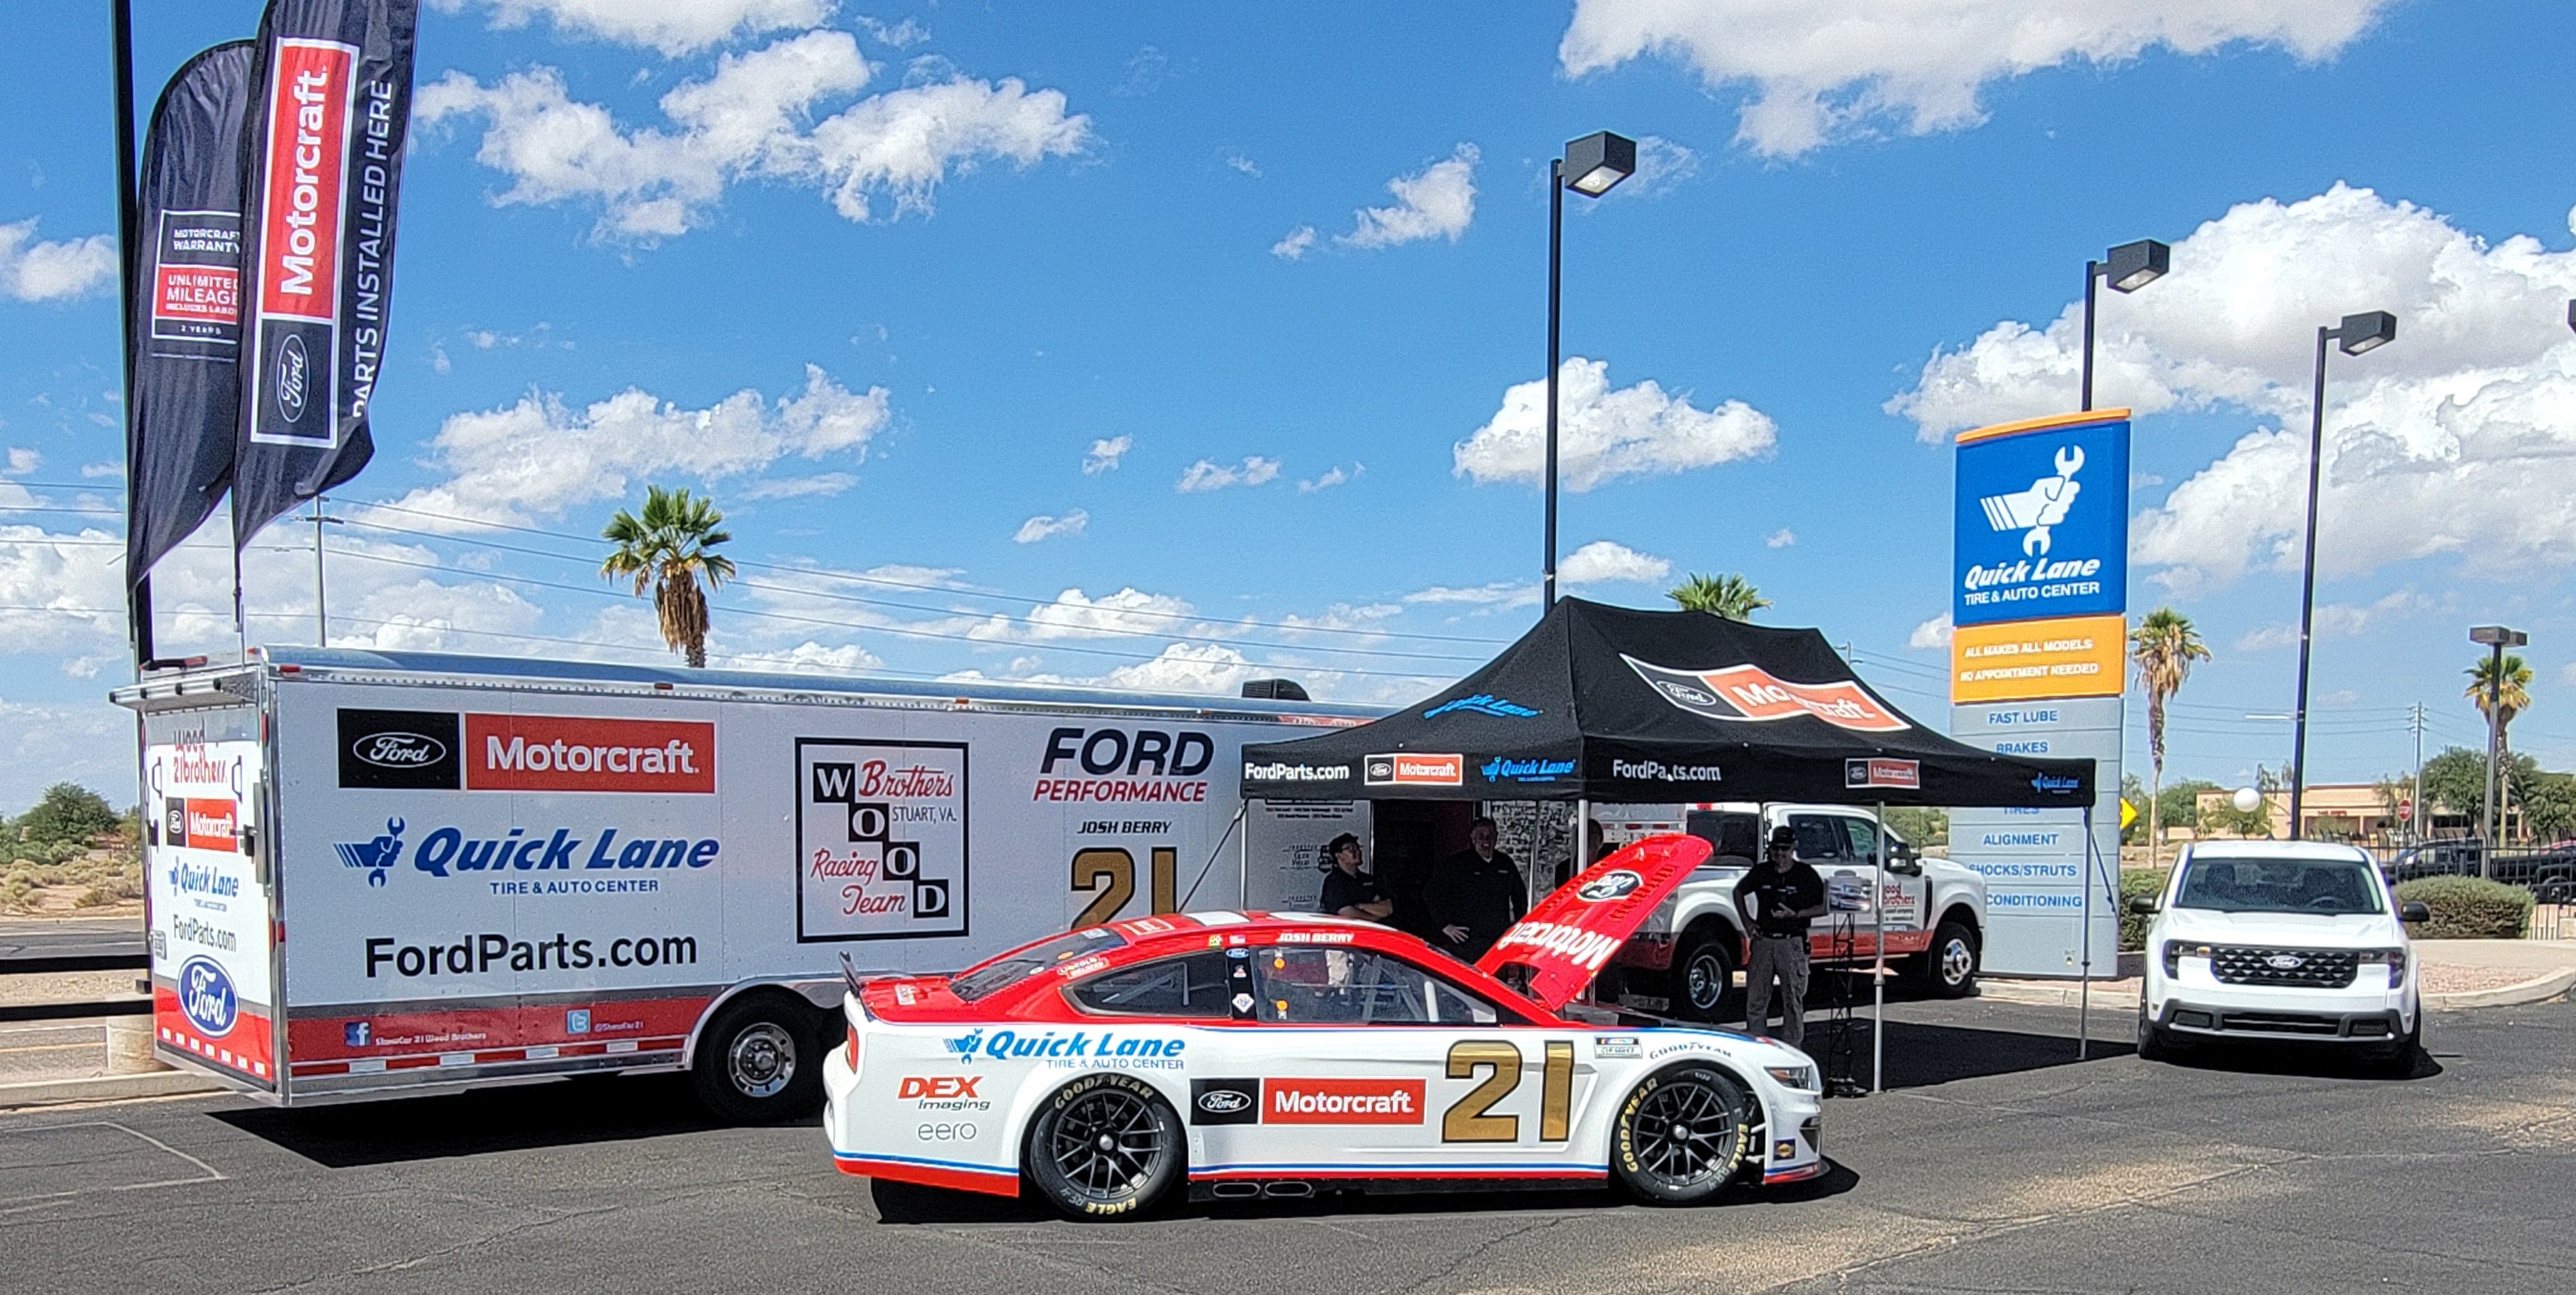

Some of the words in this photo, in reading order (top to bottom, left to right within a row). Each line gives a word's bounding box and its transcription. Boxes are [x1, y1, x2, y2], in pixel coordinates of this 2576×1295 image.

[365, 80, 391, 160] HERE
[280, 65, 328, 295] Motorcraft
[356, 165, 386, 321] INSTALLED
[209, 306, 238, 315] LABO
[281, 349, 304, 408] Ford
[353, 327, 377, 417] PARTS
[1964, 560, 2031, 590] Quick
[2031, 557, 2101, 581] Lane
[1964, 591, 1990, 606] TIRE
[1991, 590, 2001, 603] &
[2002, 586, 2038, 602] AUTO
[2041, 581, 2100, 598] CENTER
[1964, 647, 1982, 657] ALL
[1983, 644, 2019, 656] MAKES
[2021, 642, 2042, 654] ALL
[2043, 638, 2093, 652] MODELS
[1960, 671, 1974, 682] NO
[1974, 665, 2049, 680] APPOINTMENT
[2050, 663, 2100, 676] NEEDED
[1730, 682, 1877, 720] Morcraft
[1989, 712, 2020, 724] FAST
[2023, 710, 2059, 723] LUBE
[370, 736, 430, 762] Ford
[486, 735, 699, 774] Motorcraft
[1040, 727, 1215, 776] FORD
[1996, 741, 2049, 753] BRAKES
[858, 759, 954, 797] Brothers
[1245, 762, 1350, 780] FordParts.com
[1399, 761, 1457, 777] Motorcraft
[1501, 759, 1539, 777] Quick
[1538, 759, 1574, 775] Lane
[1032, 779, 1208, 802] PERFORMANCE
[892, 806, 937, 825] STUART,
[1076, 821, 1119, 835] JOSH
[1121, 821, 1172, 834] BERRY
[414, 827, 583, 878] Quick
[585, 828, 720, 869] Lane
[1983, 833, 2060, 846] ALIGNMENT
[181, 862, 211, 894] Quick
[211, 866, 239, 898] Lane
[810, 847, 879, 886] Racing
[1968, 864, 2078, 876] SHOCKS/STRUTS
[489, 882, 529, 895] TIRE
[532, 882, 543, 894] &
[546, 880, 592, 895] AUTO
[594, 879, 659, 893] CENTER
[842, 884, 906, 916] Team
[1071, 846, 1178, 931] 21
[1985, 894, 2083, 908] CONDITIONING
[173, 914, 237, 953] FordParts.com
[1277, 932, 1311, 943] JOSH
[1311, 933, 1355, 943] BERRY
[364, 932, 698, 979] FordParts.com
[188, 964, 228, 1028] Ford
[985, 1031, 1092, 1060] Quick
[1094, 1032, 1185, 1058] Lane
[1045, 1058, 1076, 1070] TIRE
[1092, 1058, 1129, 1070] AUTO
[1132, 1058, 1185, 1070] CENTER
[897, 1076, 984, 1099] DEX
[1054, 1073, 1155, 1110] GOODYEAR
[1206, 1093, 1242, 1109] Ford
[1274, 1090, 1414, 1113] Motorcraft
[1440, 1039, 1575, 1143] 21
[918, 1122, 977, 1141] eero
[1620, 1077, 1658, 1173] GOODYEAR
[1726, 1123, 1749, 1173] EAGLE
[1084, 1197, 1138, 1215] EAGLE
